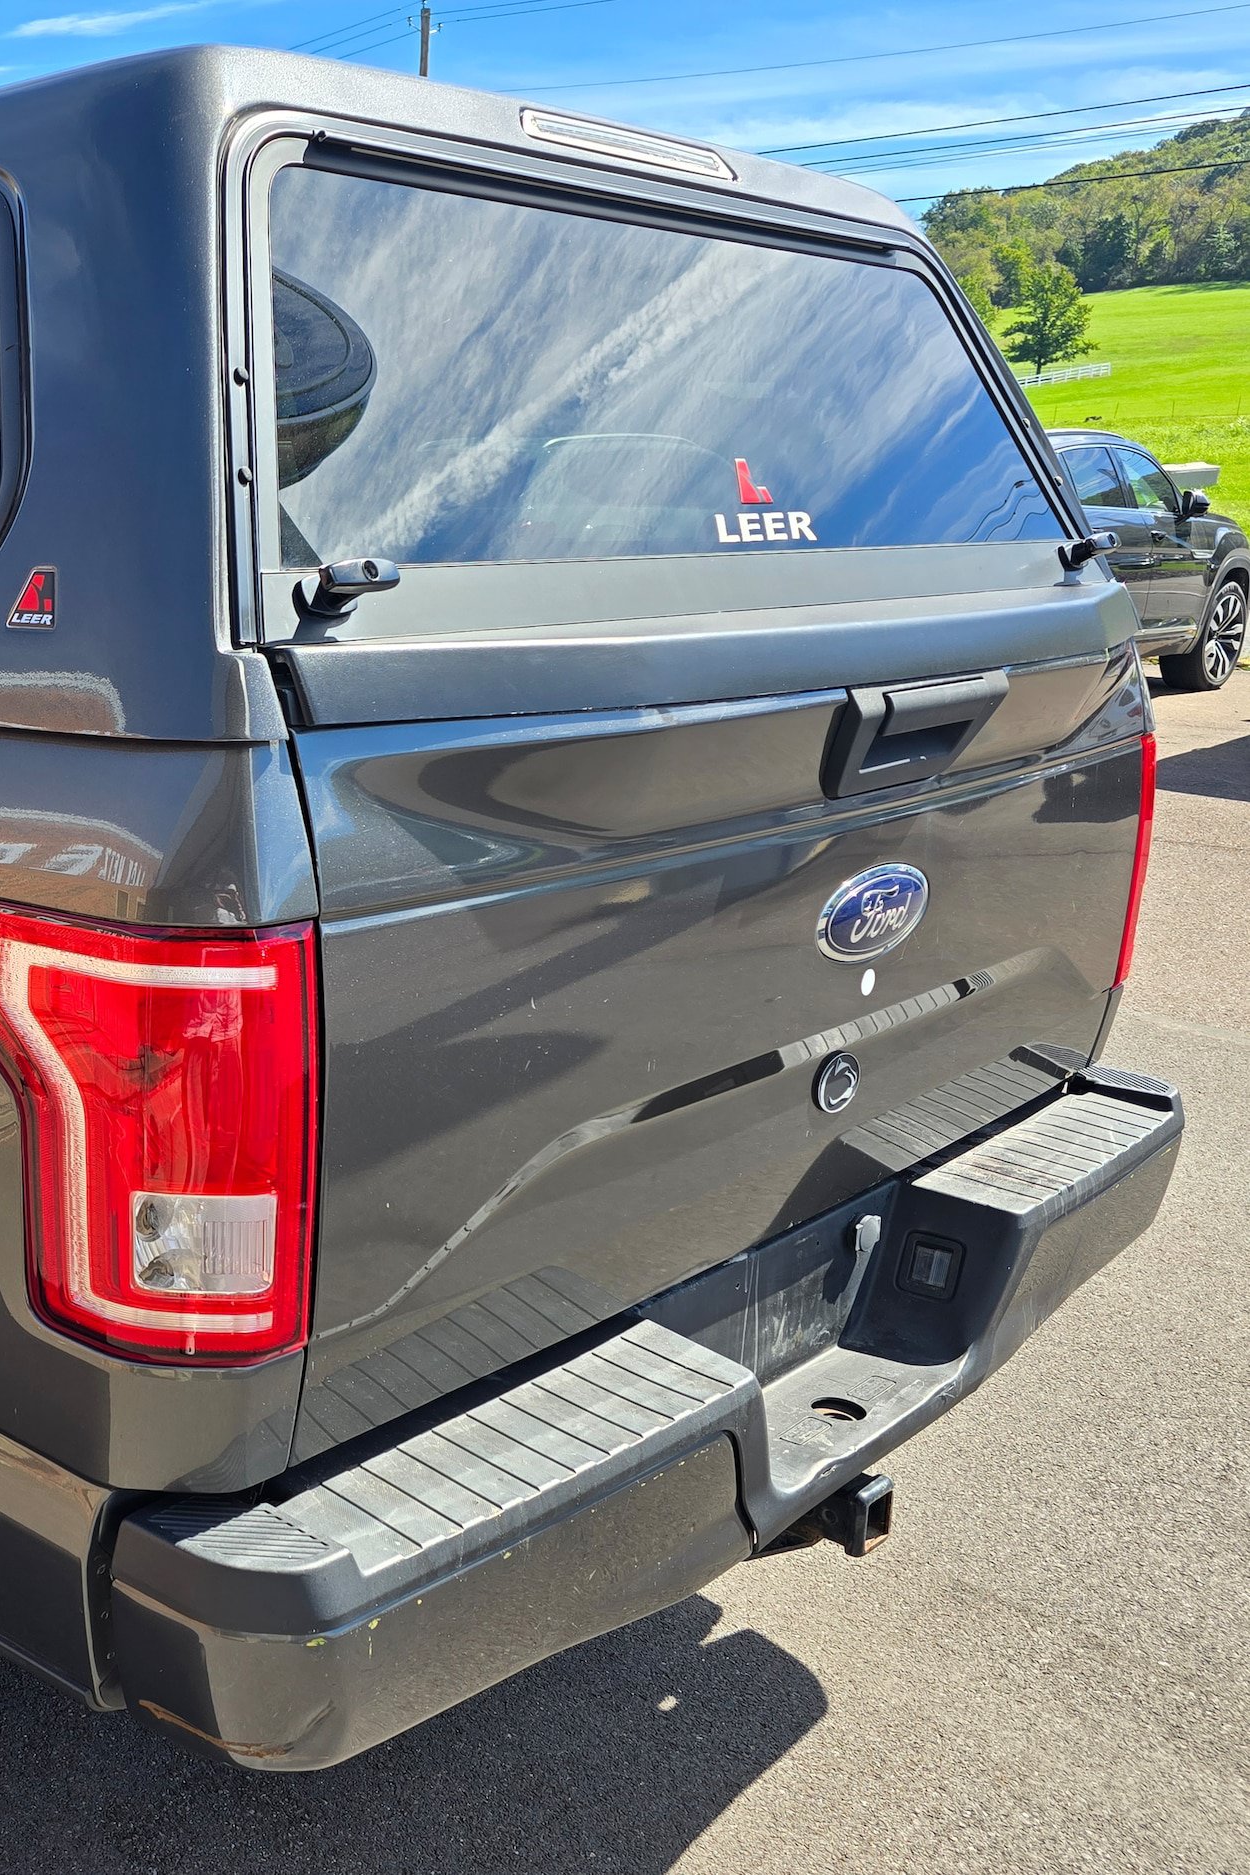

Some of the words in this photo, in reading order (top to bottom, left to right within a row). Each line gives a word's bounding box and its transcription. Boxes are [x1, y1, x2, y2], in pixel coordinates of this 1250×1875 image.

[714, 511, 818, 543] LEER
[11, 612, 53, 626] LEER
[850, 884, 913, 944] Ford
